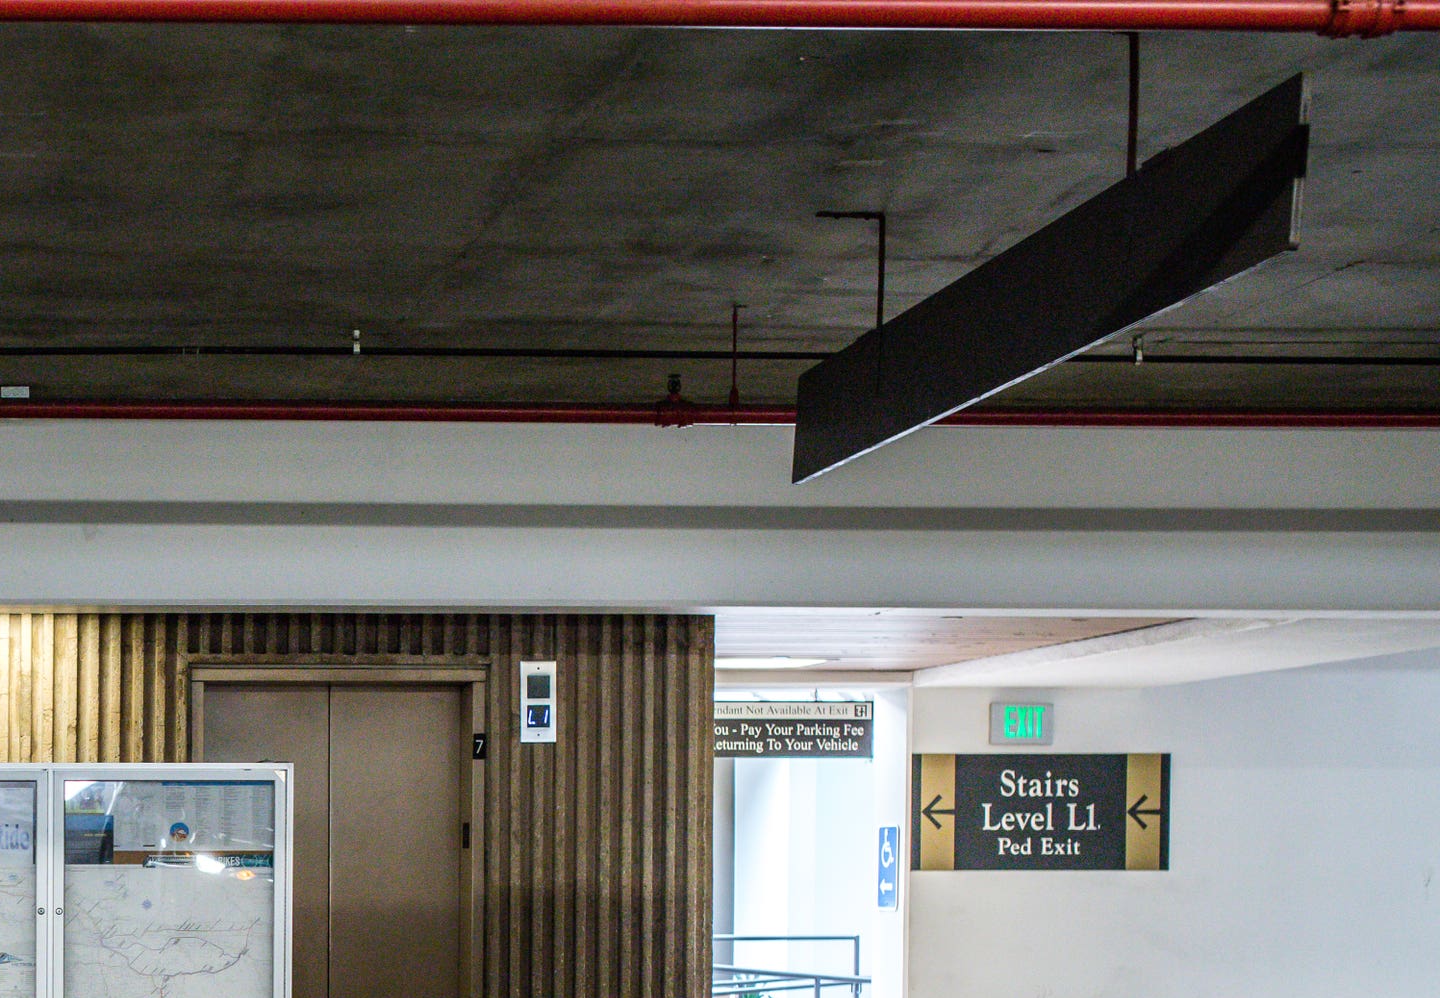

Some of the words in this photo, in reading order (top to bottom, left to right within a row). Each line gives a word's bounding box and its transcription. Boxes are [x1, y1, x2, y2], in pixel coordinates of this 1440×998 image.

[528, 709, 549, 725] L1
[714, 704, 743, 715] ndant
[746, 704, 763, 715] Not
[766, 704, 811, 715] Available
[814, 704, 826, 715] At
[829, 704, 848, 715] Exit
[1004, 706, 1045, 738] EXIT
[714, 724, 729, 735] ou
[741, 724, 762, 738] Pay
[765, 724, 794, 735] Your
[796, 724, 840, 738] Parking
[844, 724, 864, 736] Fee
[476, 740, 484, 753] 7
[714, 738, 764, 753] eturning
[766, 739, 782, 750] To
[785, 739, 814, 750] Your
[816, 738, 858, 750] Vehicle
[1000, 769, 1080, 797] Stairs
[981, 802, 1054, 831] Level
[997, 837, 1032, 855] Ped
[1041, 837, 1080, 855] Exit
